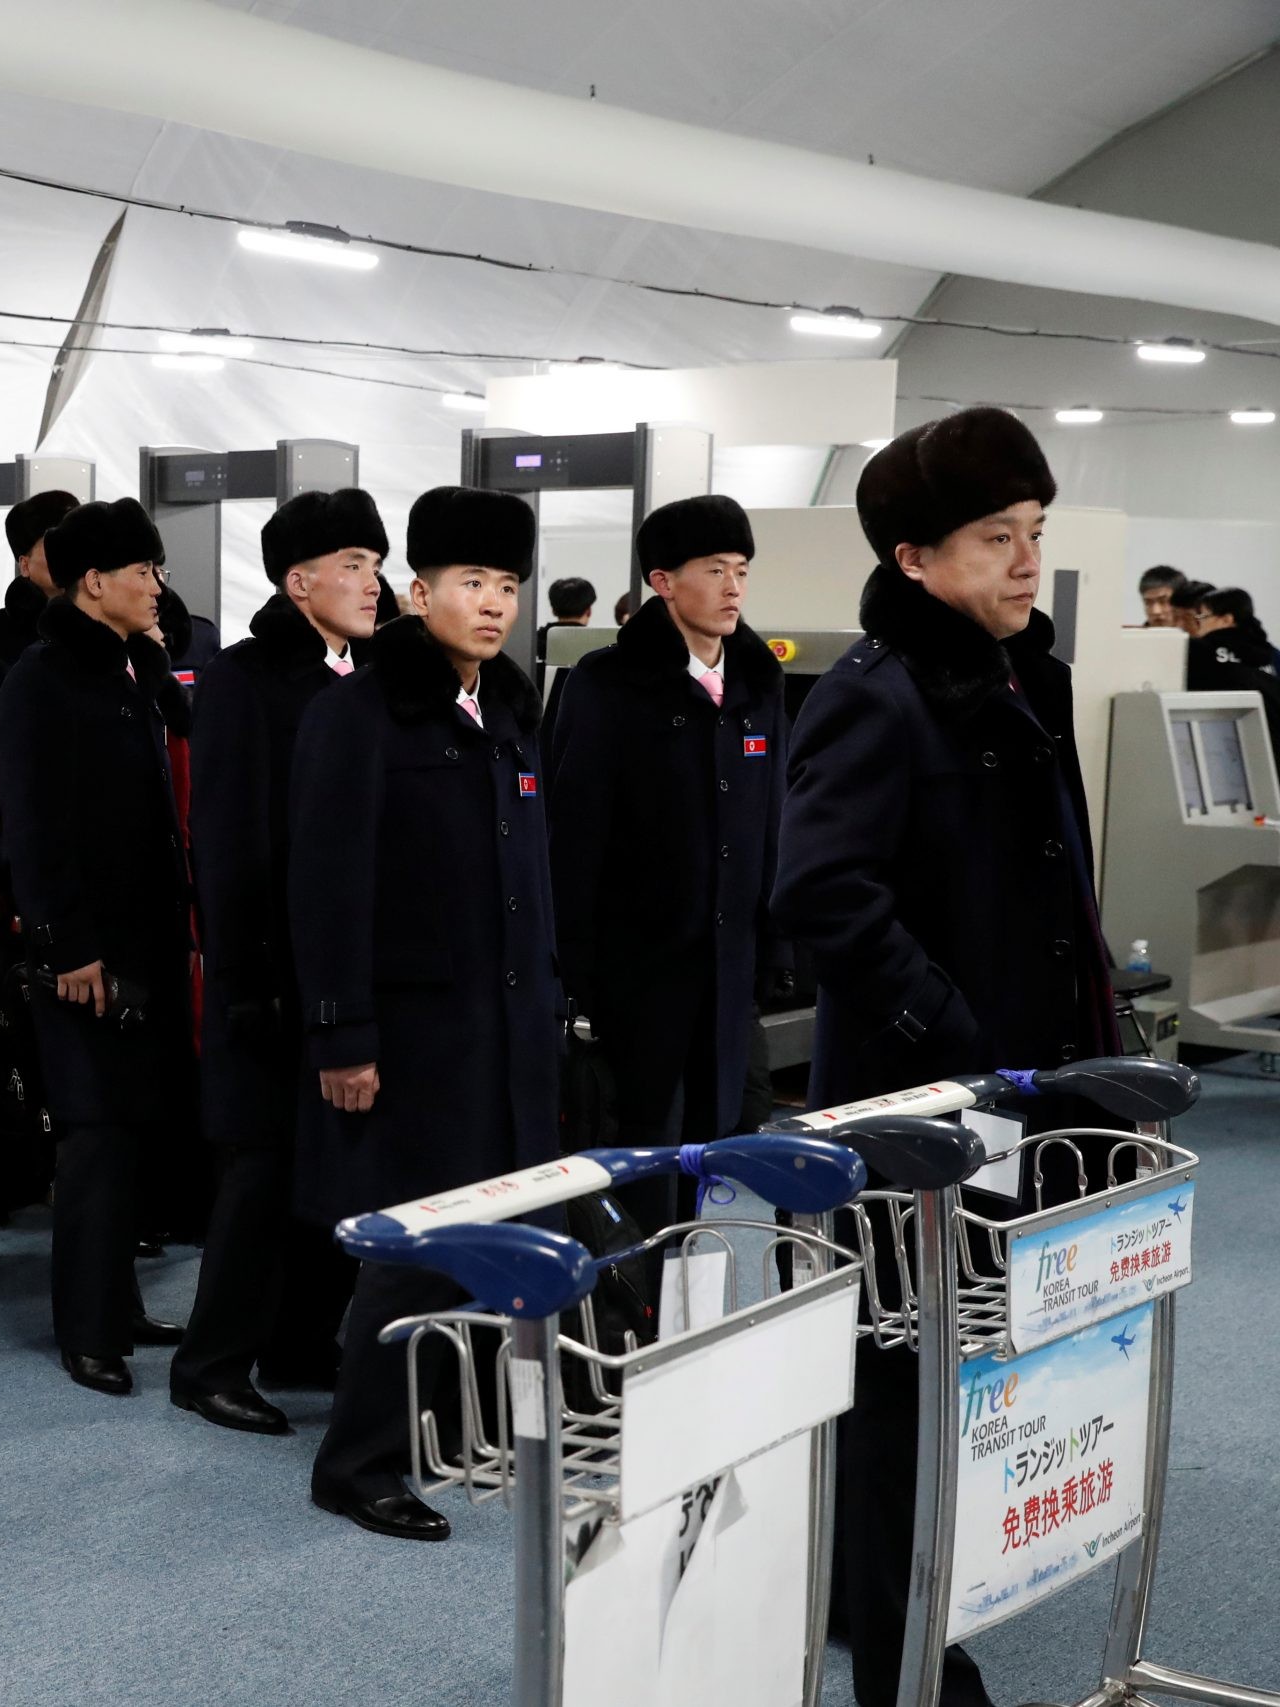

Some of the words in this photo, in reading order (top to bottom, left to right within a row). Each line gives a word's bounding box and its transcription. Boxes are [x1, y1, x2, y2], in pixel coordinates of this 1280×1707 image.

[1111, 1219, 1172, 1255] トランジットツアー
[1036, 1241, 1077, 1293] free
[1110, 1241, 1172, 1284] 免费换乘旅游
[1157, 1274, 1173, 1286] Incheon
[1043, 1278, 1070, 1298] KOREA
[1043, 1290, 1075, 1312] TRANSIT
[1076, 1280, 1099, 1299] TOUR
[961, 1371, 1019, 1438] free
[971, 1429, 1016, 1462] TRANSIT
[1019, 1415, 1046, 1441] TOUR
[972, 1416, 1008, 1444] KOREA
[1004, 1415, 1115, 1494] トランジットツアー
[1002, 1457, 1114, 1555] 免费换乘旅游
[1102, 1524, 1123, 1548] Incheon
[1124, 1512, 1141, 1537] Airport
